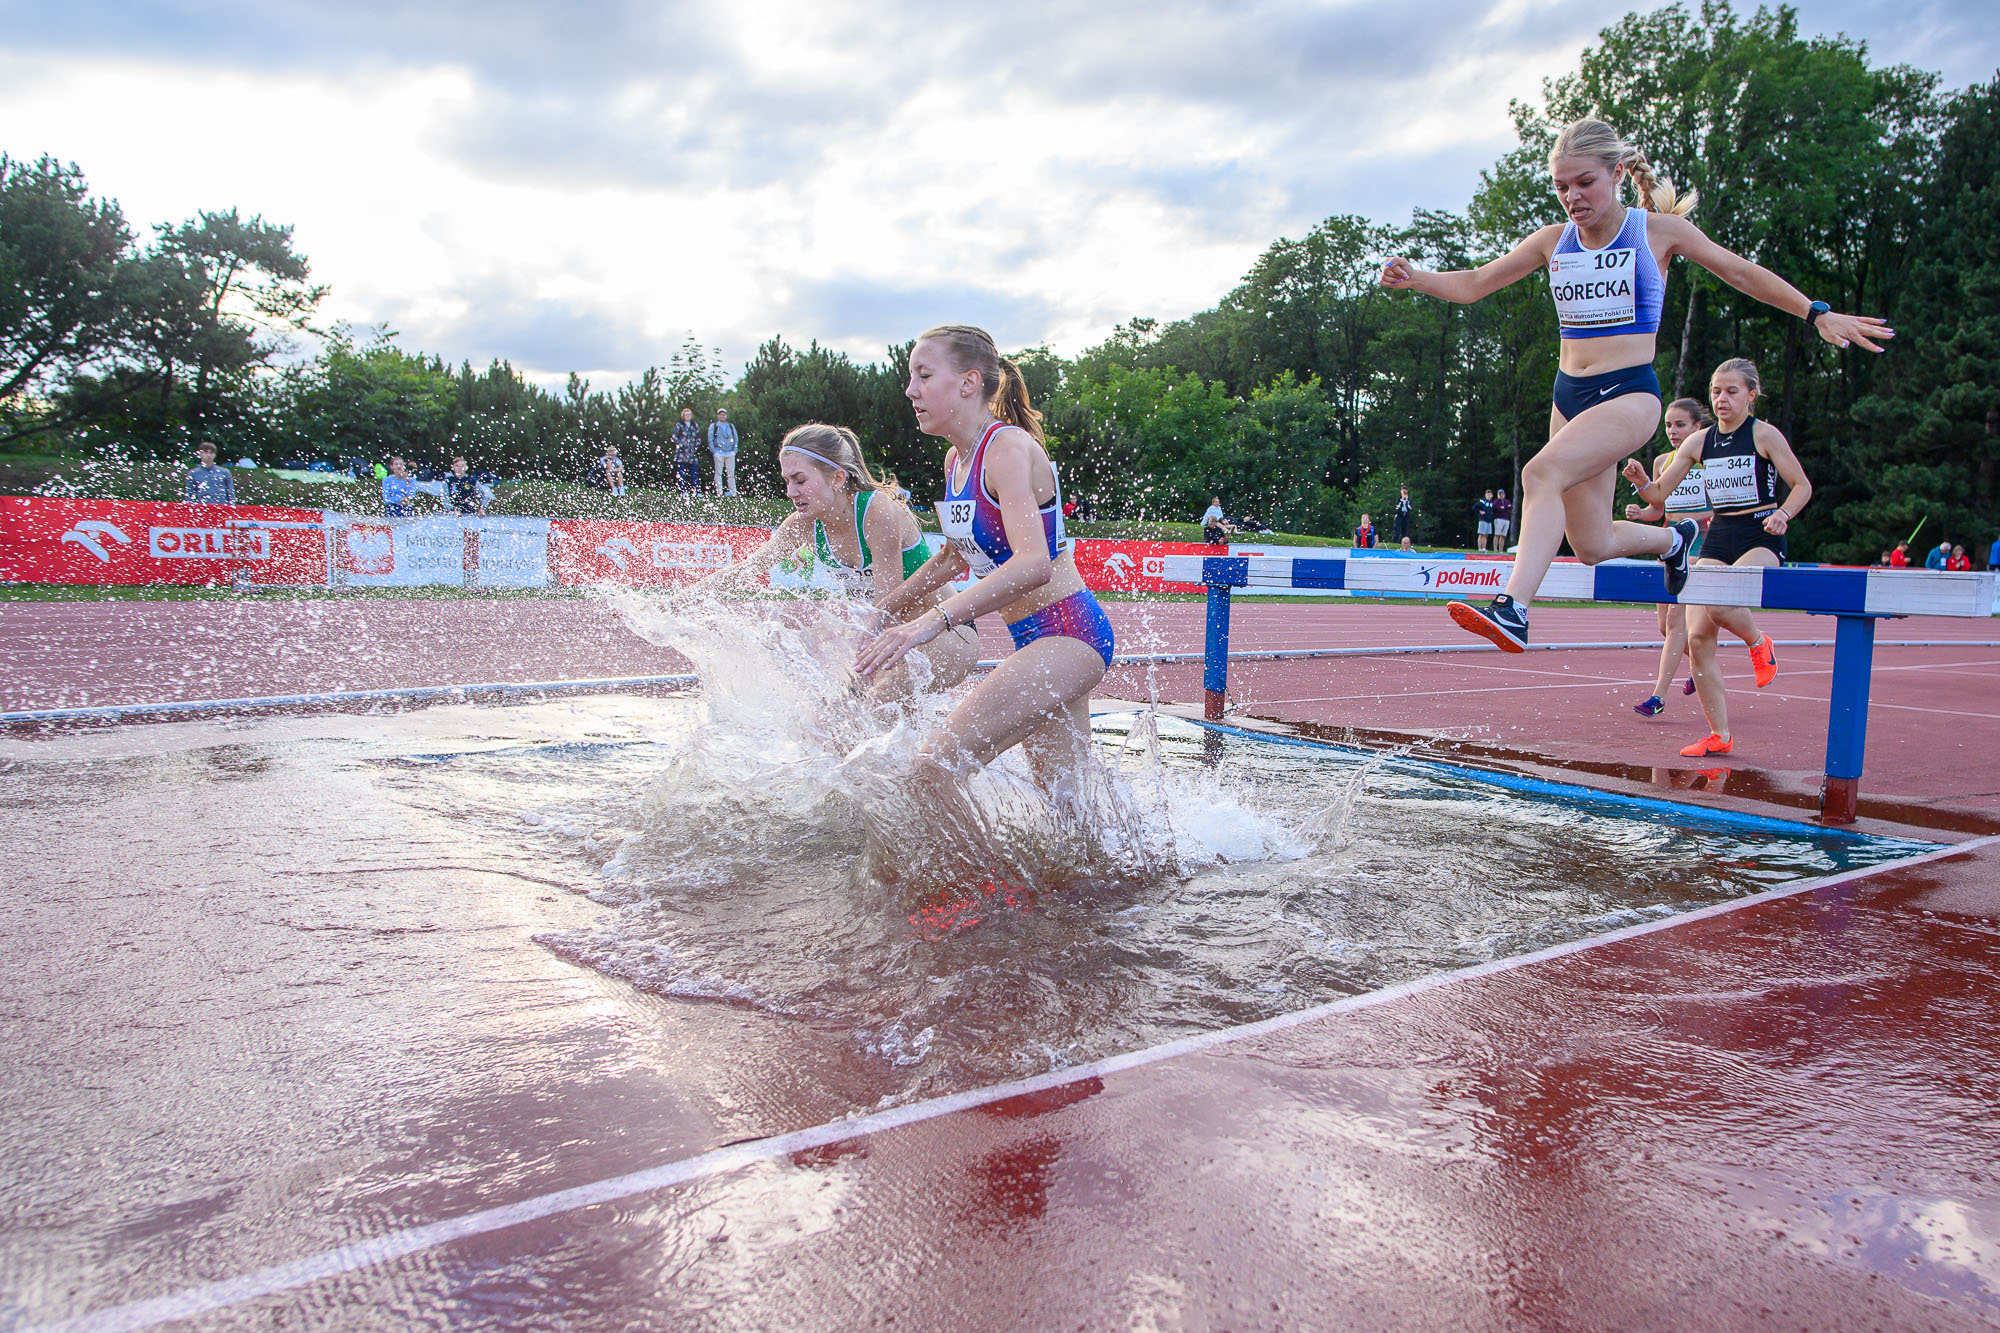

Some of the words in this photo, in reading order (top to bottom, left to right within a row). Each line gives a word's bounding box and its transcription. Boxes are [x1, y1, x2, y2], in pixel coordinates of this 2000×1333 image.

[1594, 251, 1631, 270] 107
[1554, 280, 1631, 302] GÓRECKA
[1604, 309, 1621, 318] Polski
[1727, 458, 1751, 470] 344
[1684, 471, 1702, 481] 56
[1671, 486, 1701, 497] SZKO
[951, 503, 971, 524] 583
[1754, 509, 1772, 519] NIKE
[156, 532, 262, 556] ORLEN
[1435, 567, 1502, 588] polanik
